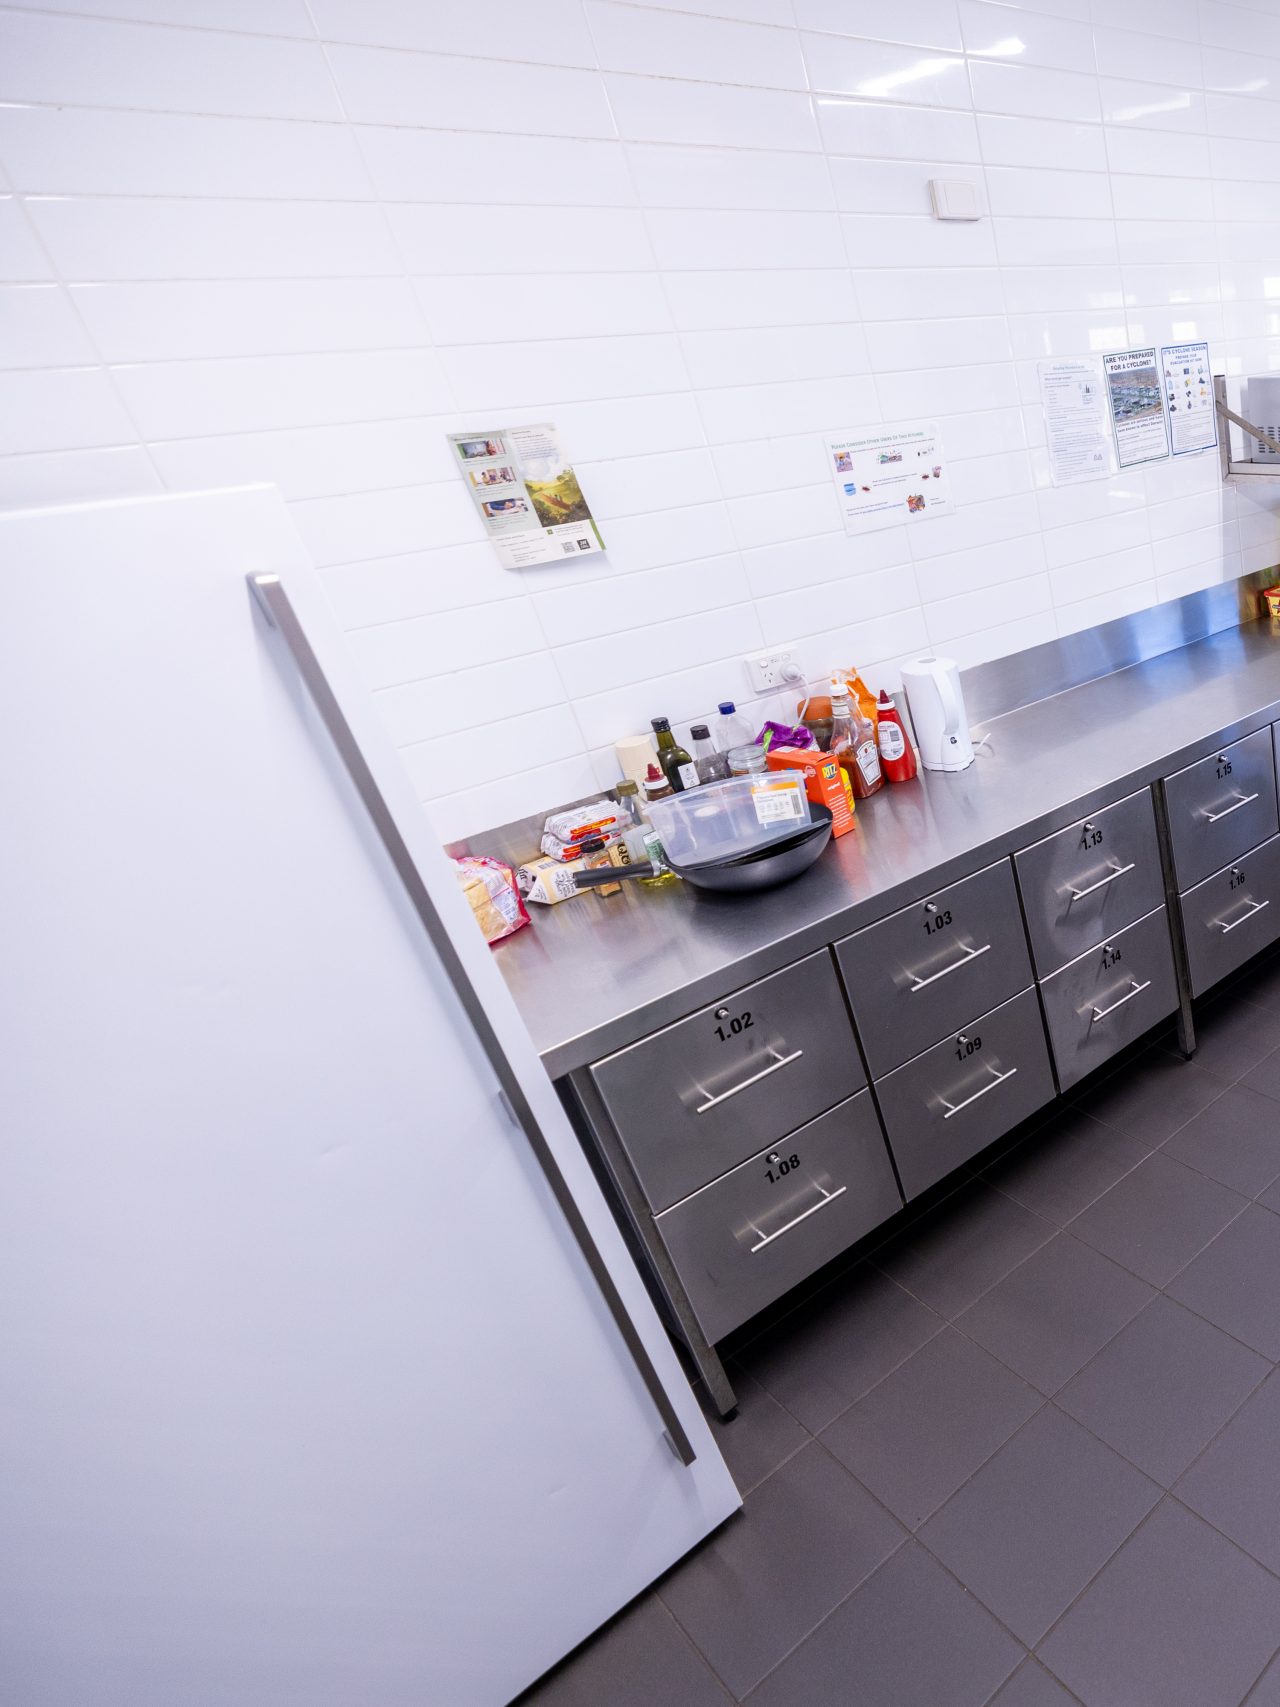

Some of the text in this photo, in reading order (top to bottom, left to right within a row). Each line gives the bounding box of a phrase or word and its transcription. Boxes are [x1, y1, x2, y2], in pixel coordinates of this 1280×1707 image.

[1127, 360, 1152, 369] CYCLONE?
[1129, 352, 1154, 360] PREPARED
[823, 764, 836, 778] RITZ
[1216, 762, 1232, 779] 1.15
[1082, 830, 1103, 850] 1.13
[1230, 873, 1245, 890] 1.16
[923, 910, 953, 935] 1.03
[1102, 950, 1122, 970] 1.14
[714, 1012, 754, 1042] 1.02
[955, 1037, 982, 1061] 1.09
[764, 1154, 800, 1184] 1.08
